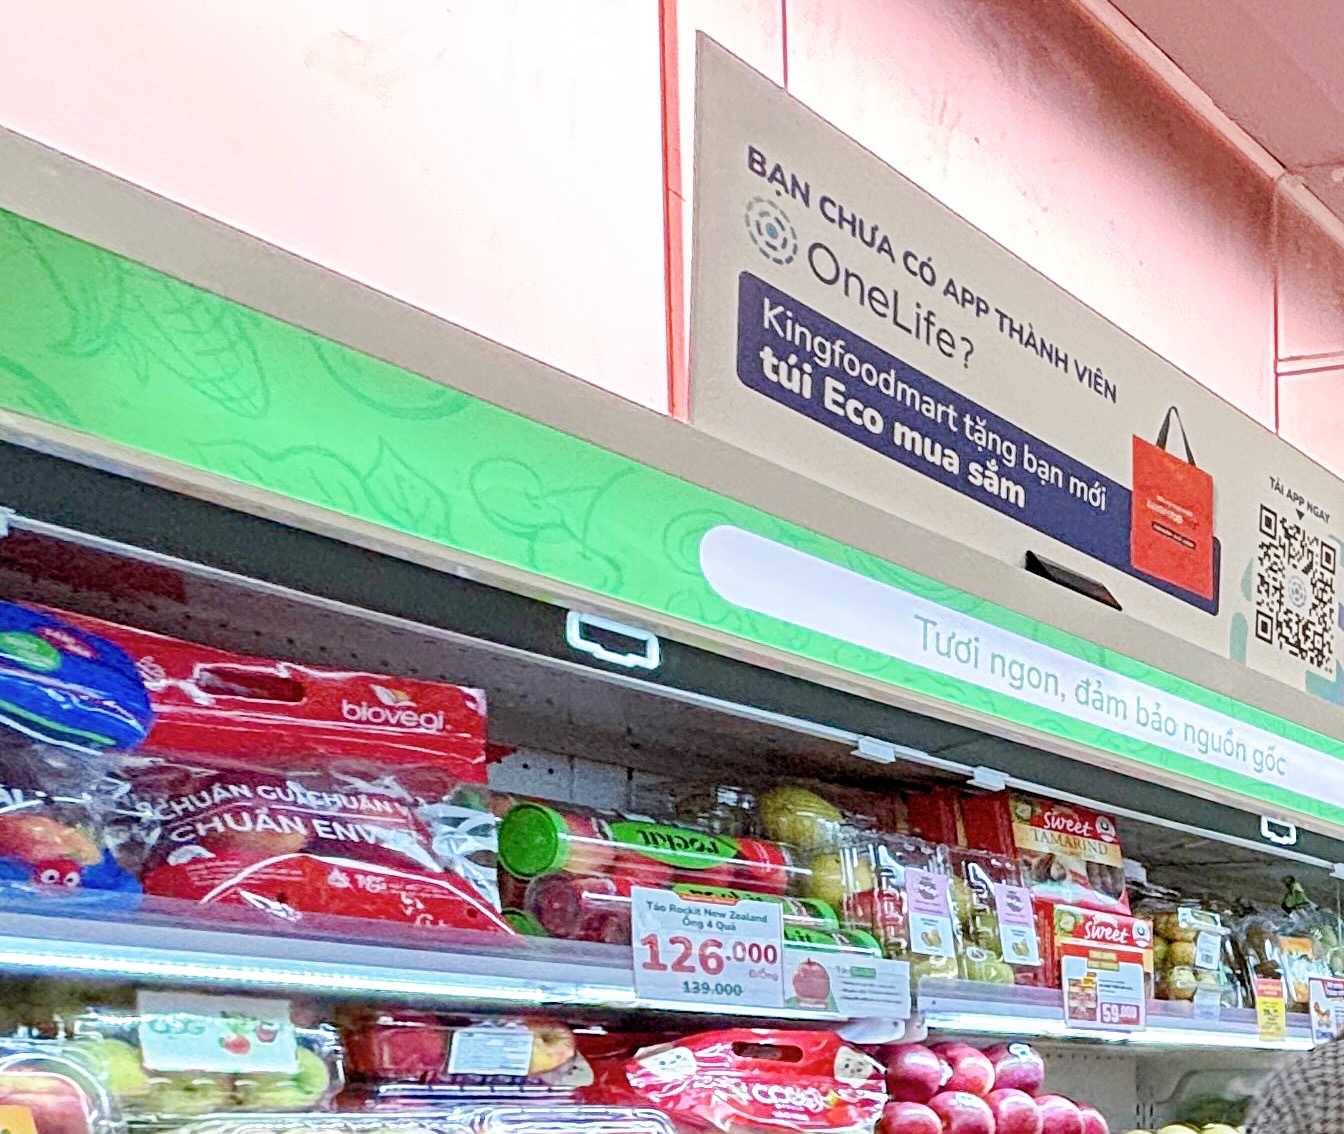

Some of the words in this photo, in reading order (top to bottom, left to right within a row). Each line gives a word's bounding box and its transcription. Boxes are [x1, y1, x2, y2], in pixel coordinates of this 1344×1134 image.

[748, 145, 810, 208] BẠN
[819, 195, 896, 264] CHƯA
[902, 250, 937, 287] CÓ
[943, 277, 990, 318] APP
[995, 307, 1068, 374] THÀNH
[1074, 359, 1117, 404] VIÊN
[808, 242, 974, 369] OneLife?
[763, 297, 959, 432] Kingfoodmart
[963, 414, 1016, 468] tặng
[1023, 444, 1063, 488] bạn
[1069, 475, 1107, 511] mới
[759, 345, 812, 399] túi
[824, 375, 884, 435] Eco
[894, 421, 960, 475] mua
[968, 458, 1026, 509] sắm
[1286, 487, 1305, 506] APP
[1307, 500, 1331, 525] NGAY
[914, 614, 980, 669] Tươi
[990, 652, 1066, 703] ngon,
[1074, 678, 1128, 721] đảm
[1136, 696, 1177, 737] bảo
[1184, 723, 1247, 762] nguồn
[1252, 745, 1287, 776] gốc
[1043, 811, 1094, 837] Sweet
[1032, 828, 1109, 856] TAMARIND
[646, 900, 667, 912] Táo
[669, 903, 702, 916] Rockit
[703, 908, 727, 919] New
[729, 910, 768, 924] Zealand
[706, 919, 713, 928] 4
[1084, 920, 1131, 944] Sweet
[683, 980, 744, 997] 139.000
